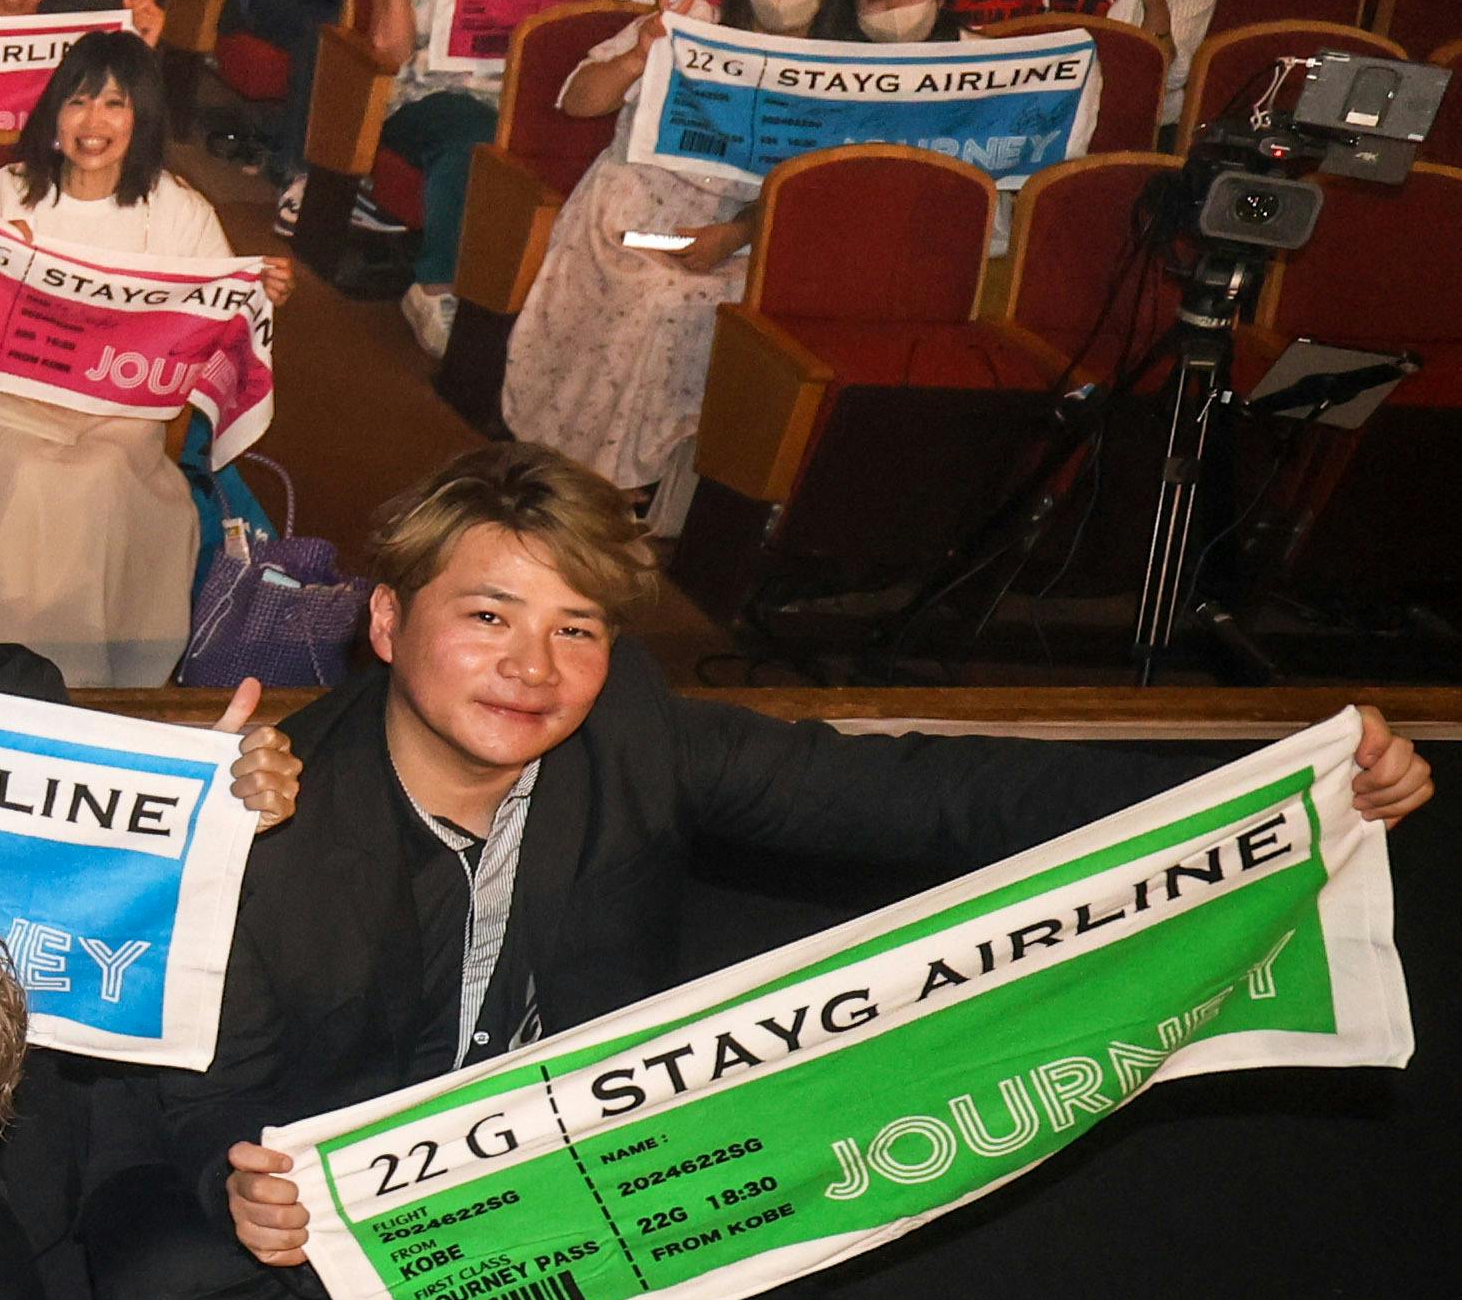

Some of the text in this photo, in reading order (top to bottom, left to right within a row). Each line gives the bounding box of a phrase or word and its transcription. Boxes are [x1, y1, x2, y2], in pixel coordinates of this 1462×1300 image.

[686, 48, 1081, 94] 22 G STAYG AIRLINE
[42, 267, 173, 308] STAYG
[368, 812, 1293, 1196] 22 G STAYG AIRLINE
[617, 1137, 764, 1197] 2024622SG
[373, 1206, 429, 1233] FLIGHT
[380, 1190, 521, 1244] 2024622SG
[637, 1176, 778, 1236] 22G 18:30
[390, 1239, 438, 1264] FROM
[650, 1203, 796, 1263] FROM KOBE
[399, 1244, 465, 1281] KOBE
[414, 1254, 512, 1300] FIRST CLASS
[535, 1241, 601, 1275] PASS
